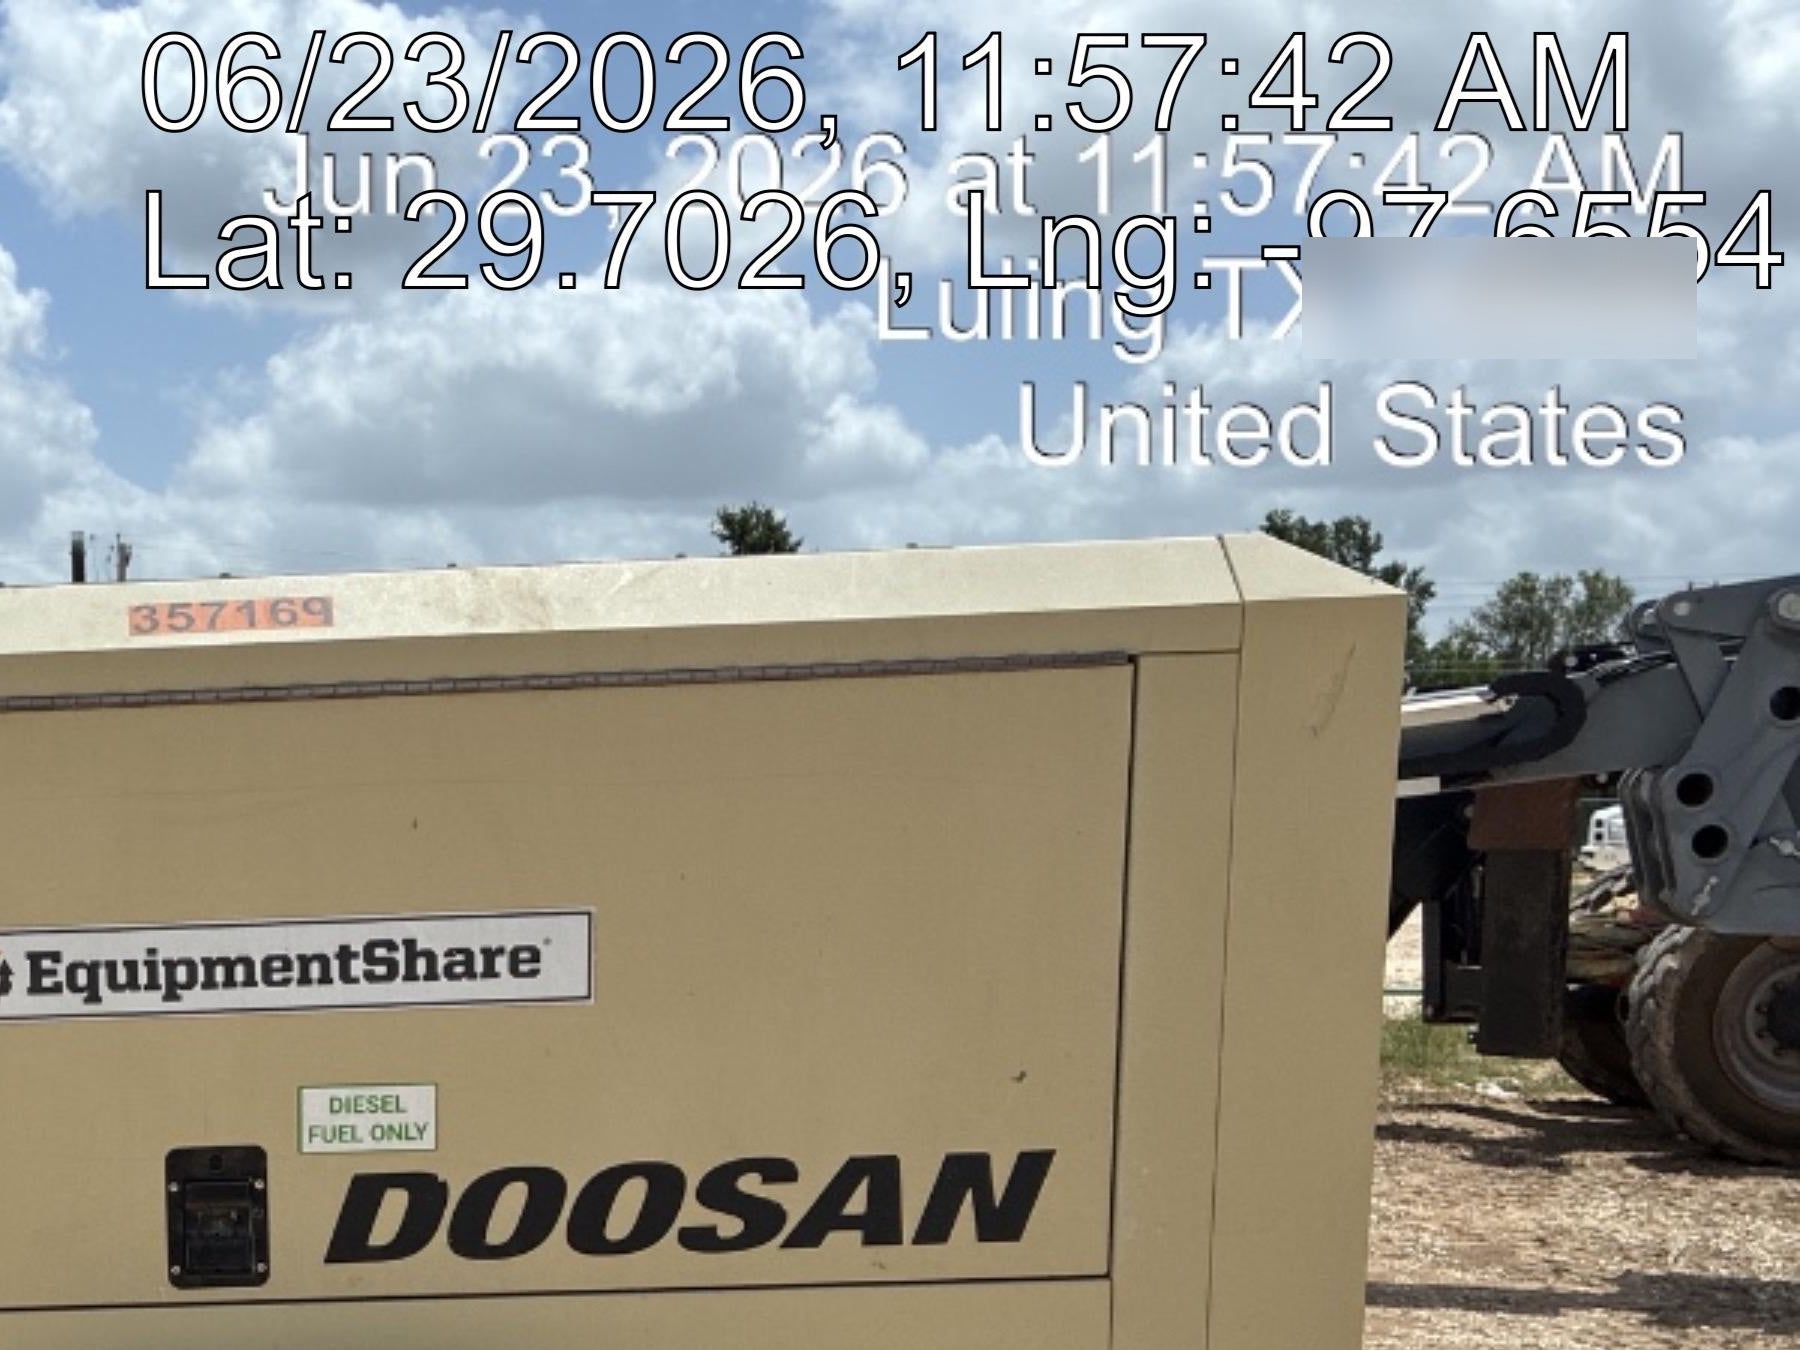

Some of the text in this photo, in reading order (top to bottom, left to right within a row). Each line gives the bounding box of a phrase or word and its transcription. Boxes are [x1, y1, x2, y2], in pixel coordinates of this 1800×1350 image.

[130, 596, 334, 634] 357169
[26, 938, 542, 1003] EquipmentShare
[328, 1093, 408, 1115] DIESEL
[308, 1121, 429, 1144] FUEL ONLY
[323, 1148, 1057, 1265] DOOSAN
